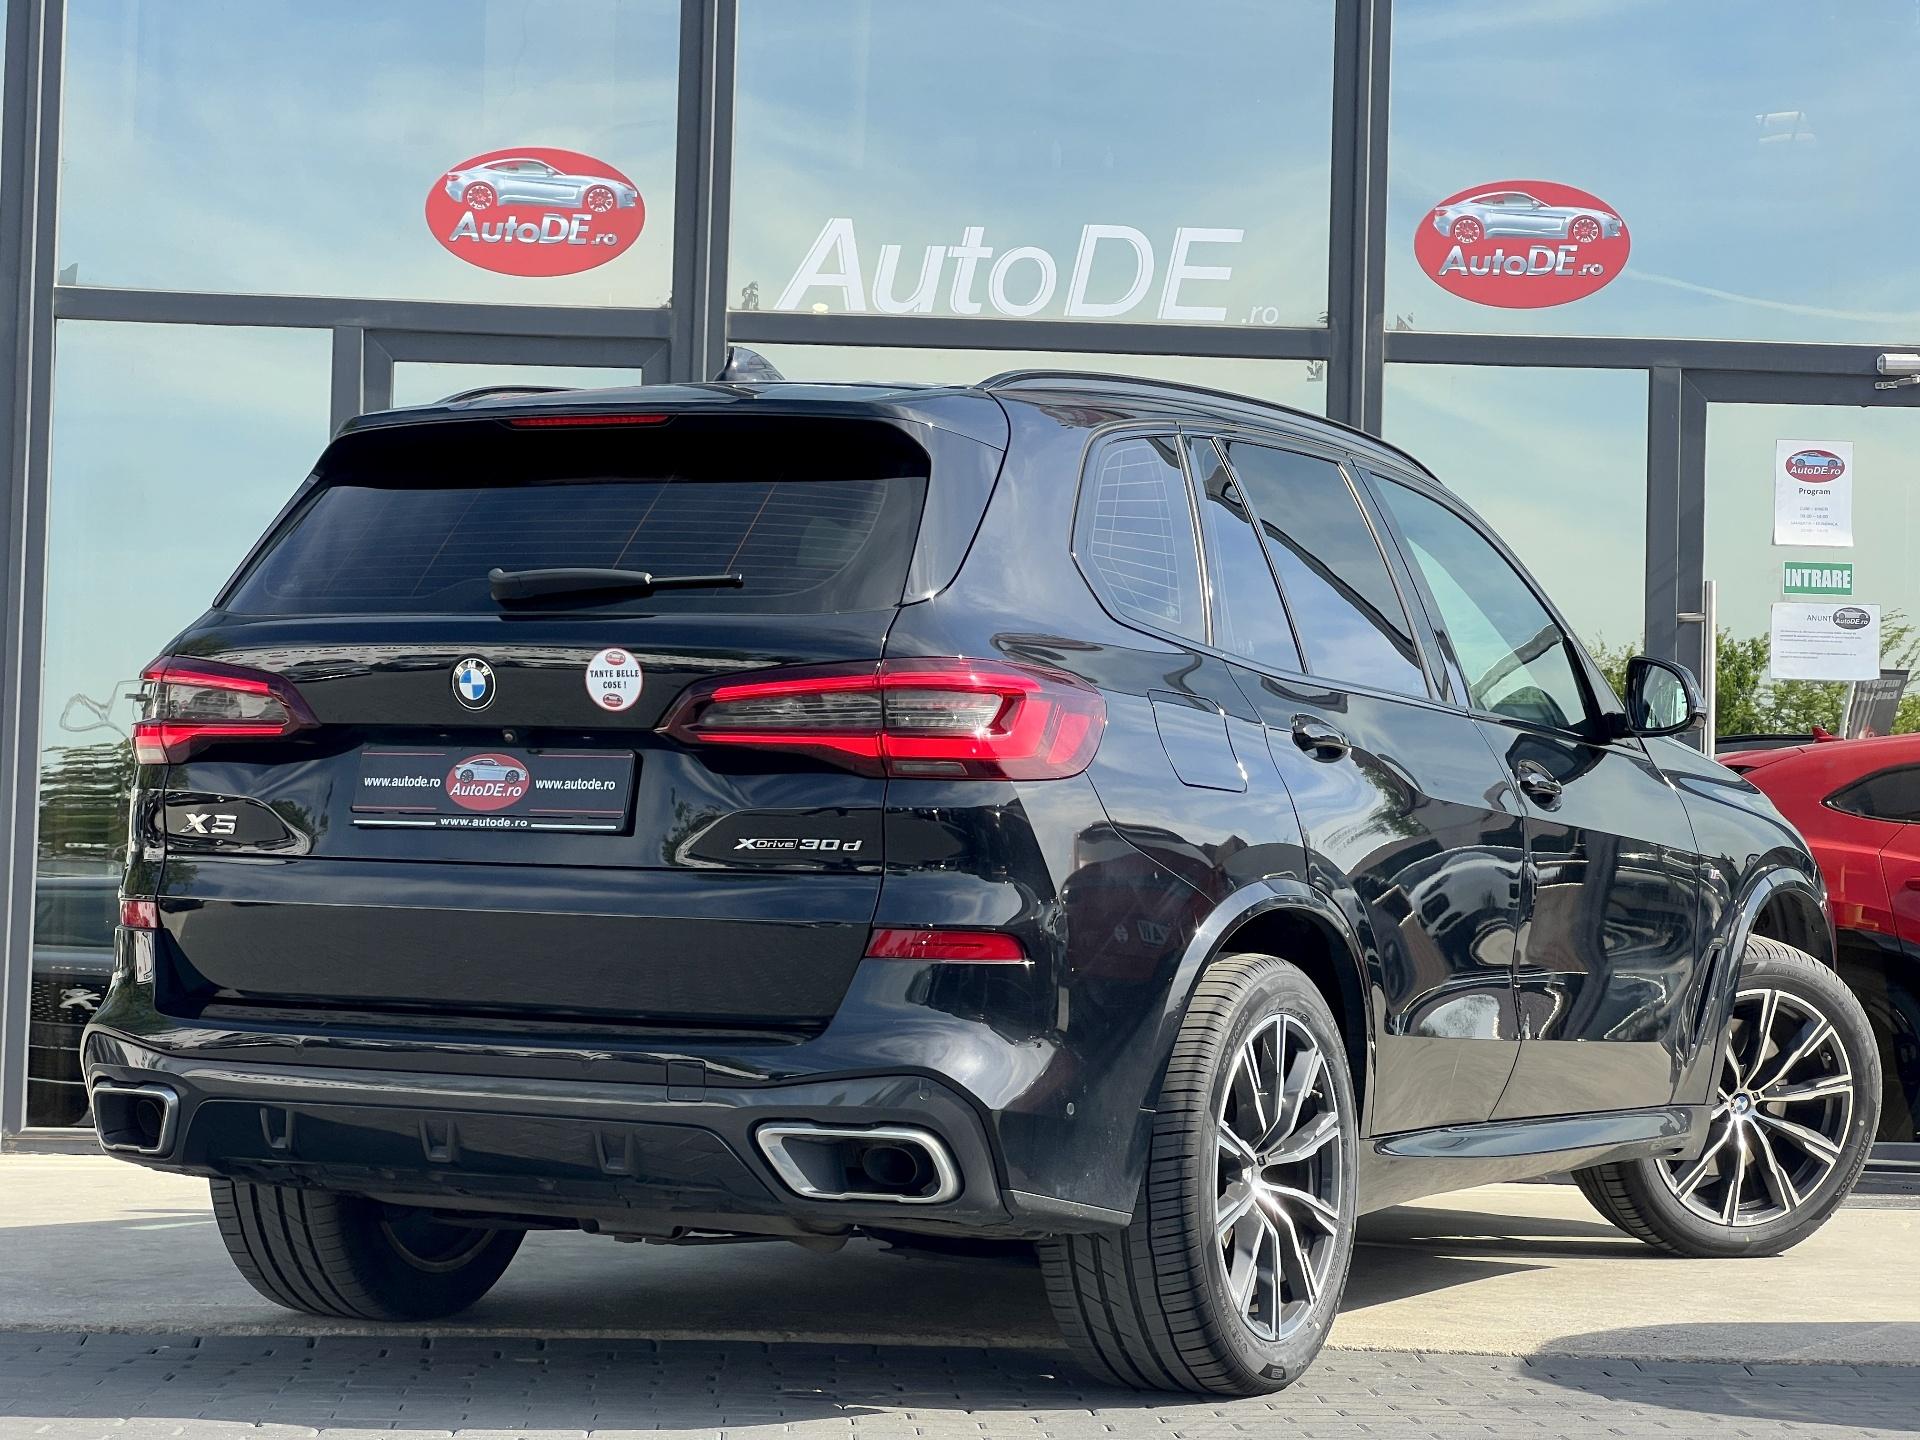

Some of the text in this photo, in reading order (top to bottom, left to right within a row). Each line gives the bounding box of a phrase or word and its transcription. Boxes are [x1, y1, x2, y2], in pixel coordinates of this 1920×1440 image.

[1790, 466, 1841, 475] AutoDE.ro
[1798, 487, 1831, 496] Program
[1785, 568, 1851, 588] INTRARE
[590, 670, 640, 678] TANTE BELLE
[602, 681, 622, 689] COSE
[363, 775, 441, 788] www.autode.ro
[535, 778, 617, 791] www.autode.ro
[450, 782, 523, 798] AutoDE.ro
[179, 813, 238, 835] X5
[440, 816, 529, 828] www.autode.ro
